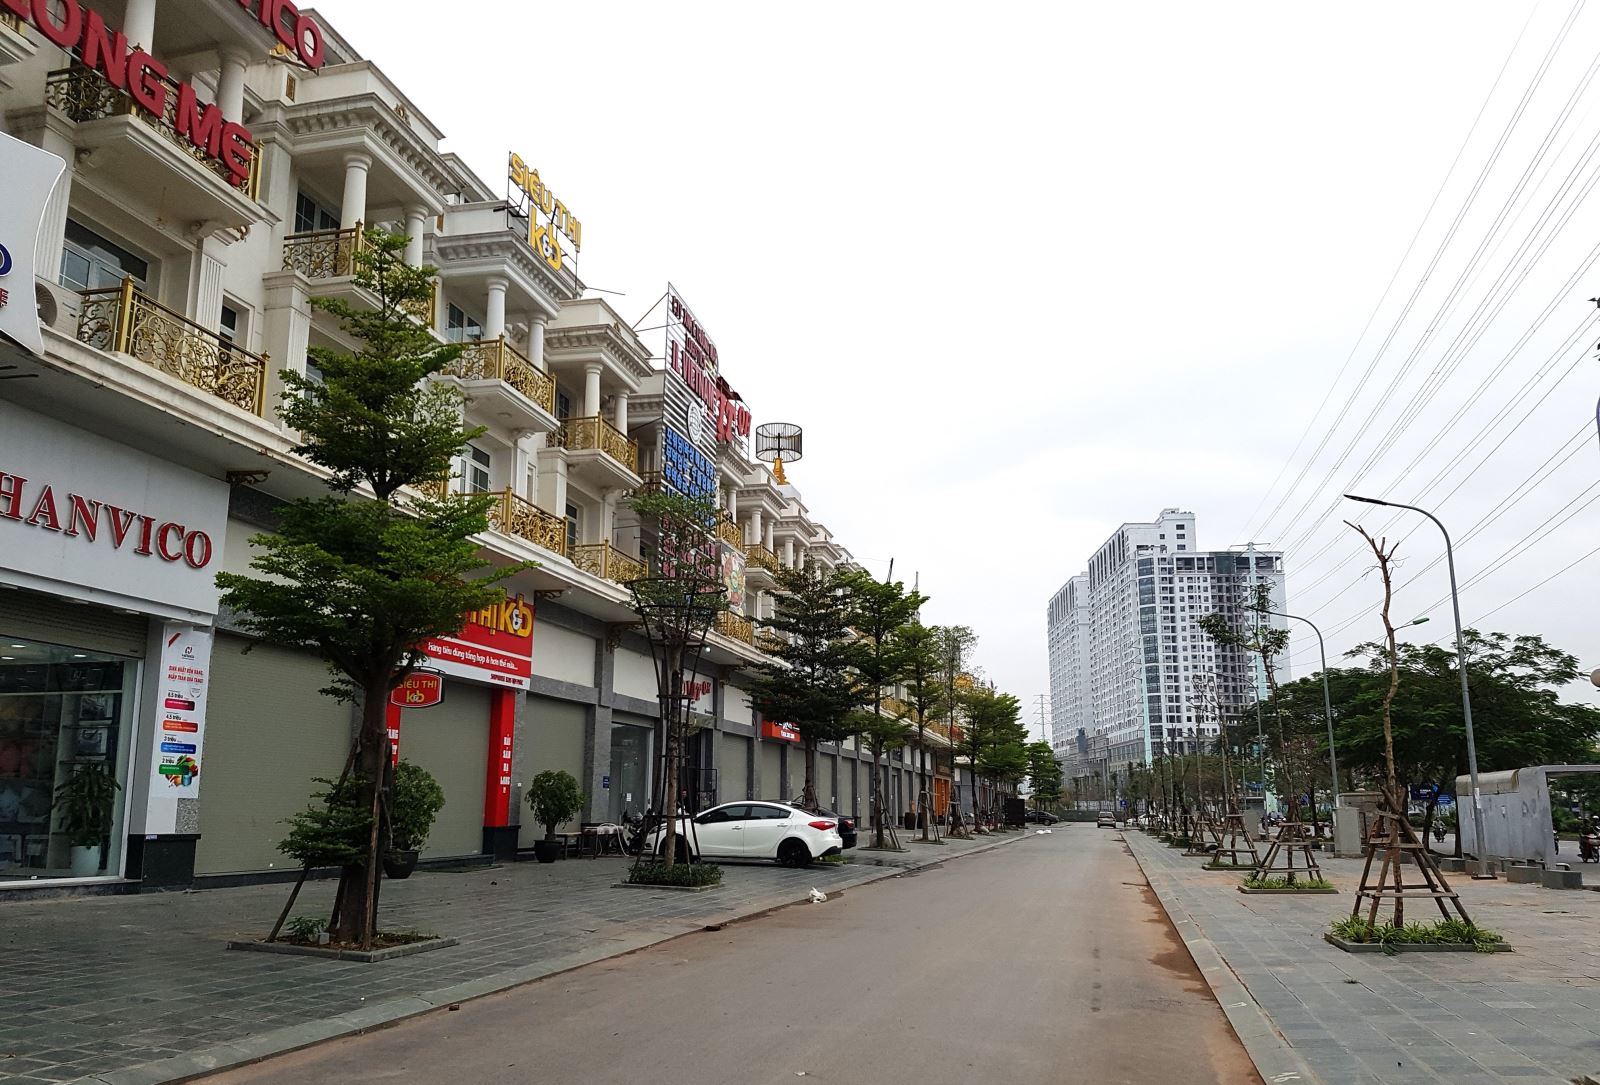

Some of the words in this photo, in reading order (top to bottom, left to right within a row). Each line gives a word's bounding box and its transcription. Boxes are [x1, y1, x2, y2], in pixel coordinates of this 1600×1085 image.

[175, 80, 252, 187] MẸ
[511, 152, 553, 215] SIÊU
[555, 198, 582, 254] THỊ
